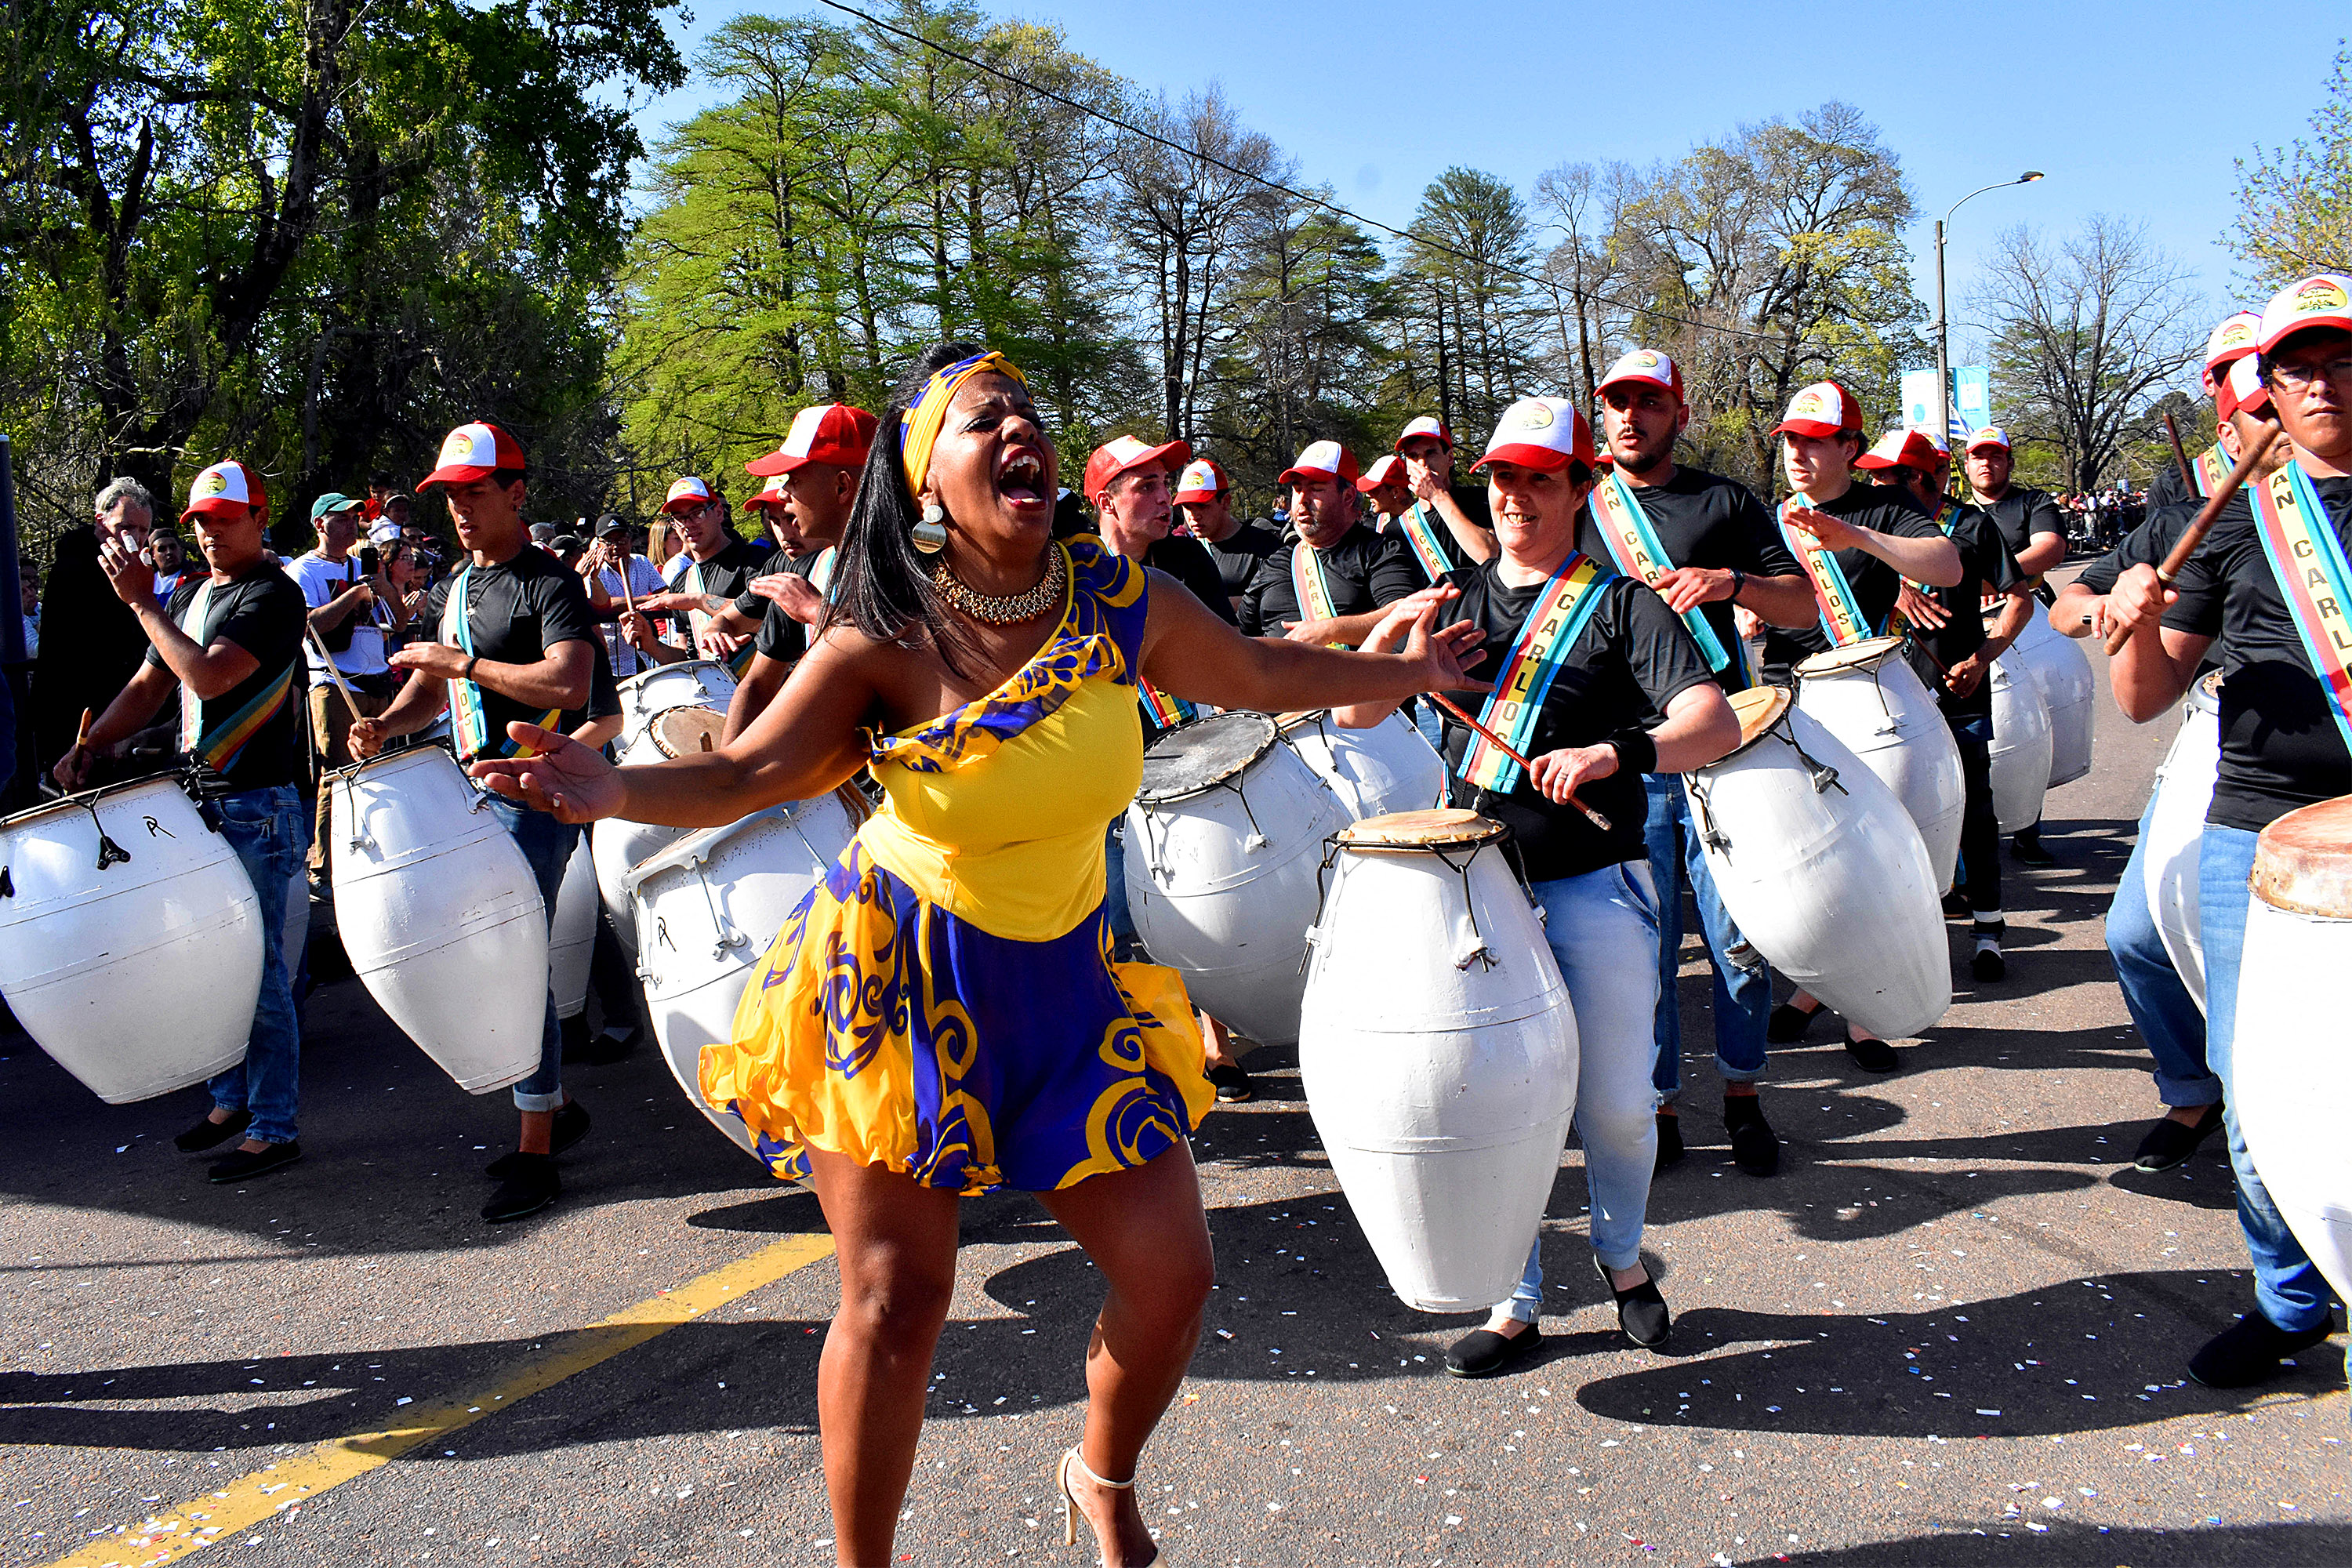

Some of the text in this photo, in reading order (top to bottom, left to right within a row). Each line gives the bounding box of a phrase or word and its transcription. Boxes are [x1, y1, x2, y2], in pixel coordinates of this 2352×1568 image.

[2272, 474, 2295, 510] AN
[1305, 566, 1323, 615] CARL
[1490, 593, 1575, 751] CARLOS
